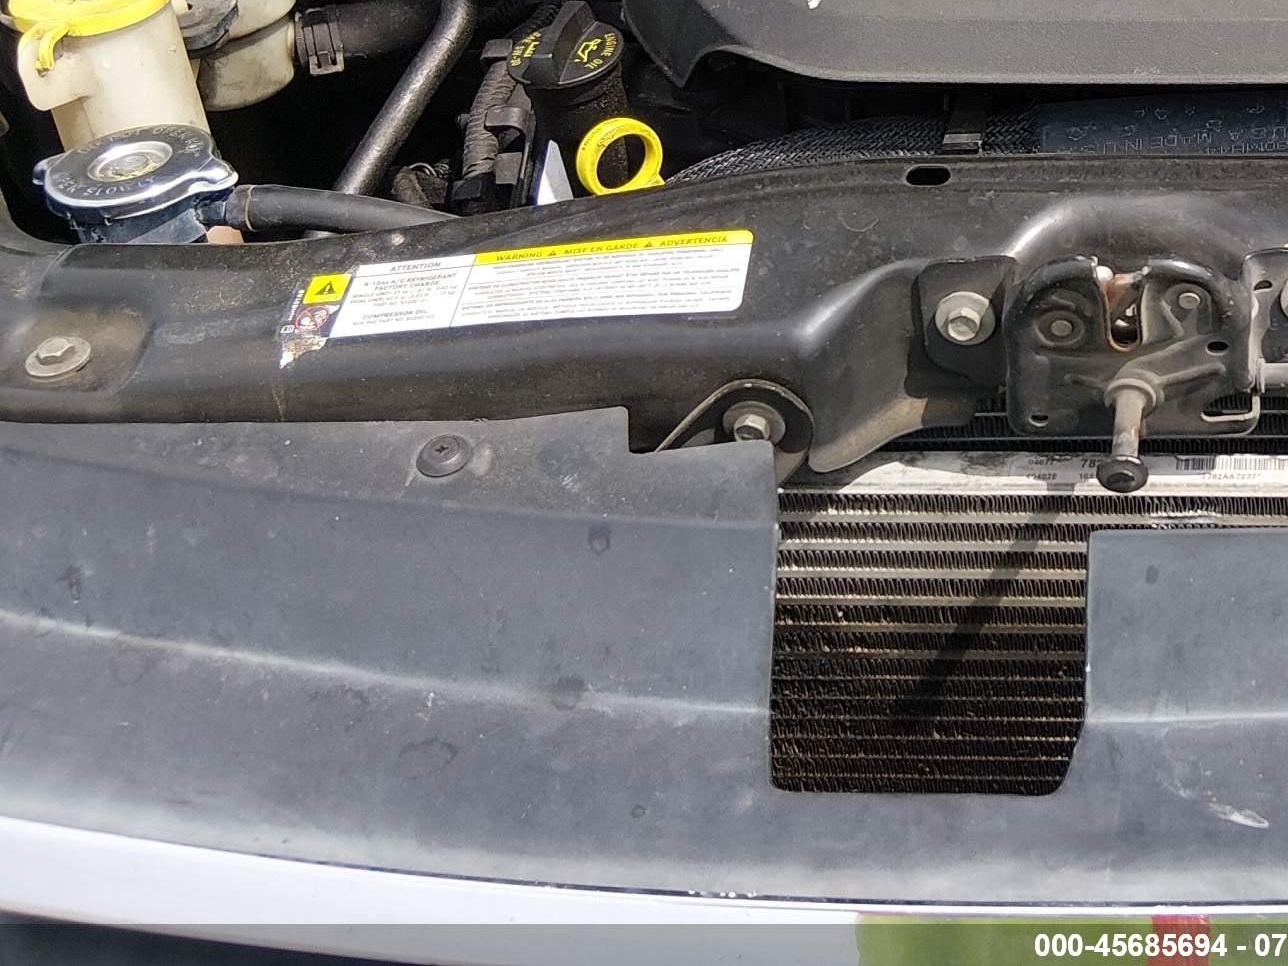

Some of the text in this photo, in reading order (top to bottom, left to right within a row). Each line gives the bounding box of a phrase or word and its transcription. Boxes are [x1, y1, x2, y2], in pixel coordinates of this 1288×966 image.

[584, 32, 617, 71] ENGINE OIL
[496, 250, 543, 262] WARNING
[564, 247, 588, 255] MISE
[606, 242, 639, 251] GARDE
[659, 236, 728, 247] ADVERTENCIA
[389, 262, 441, 272] ATTENTION
